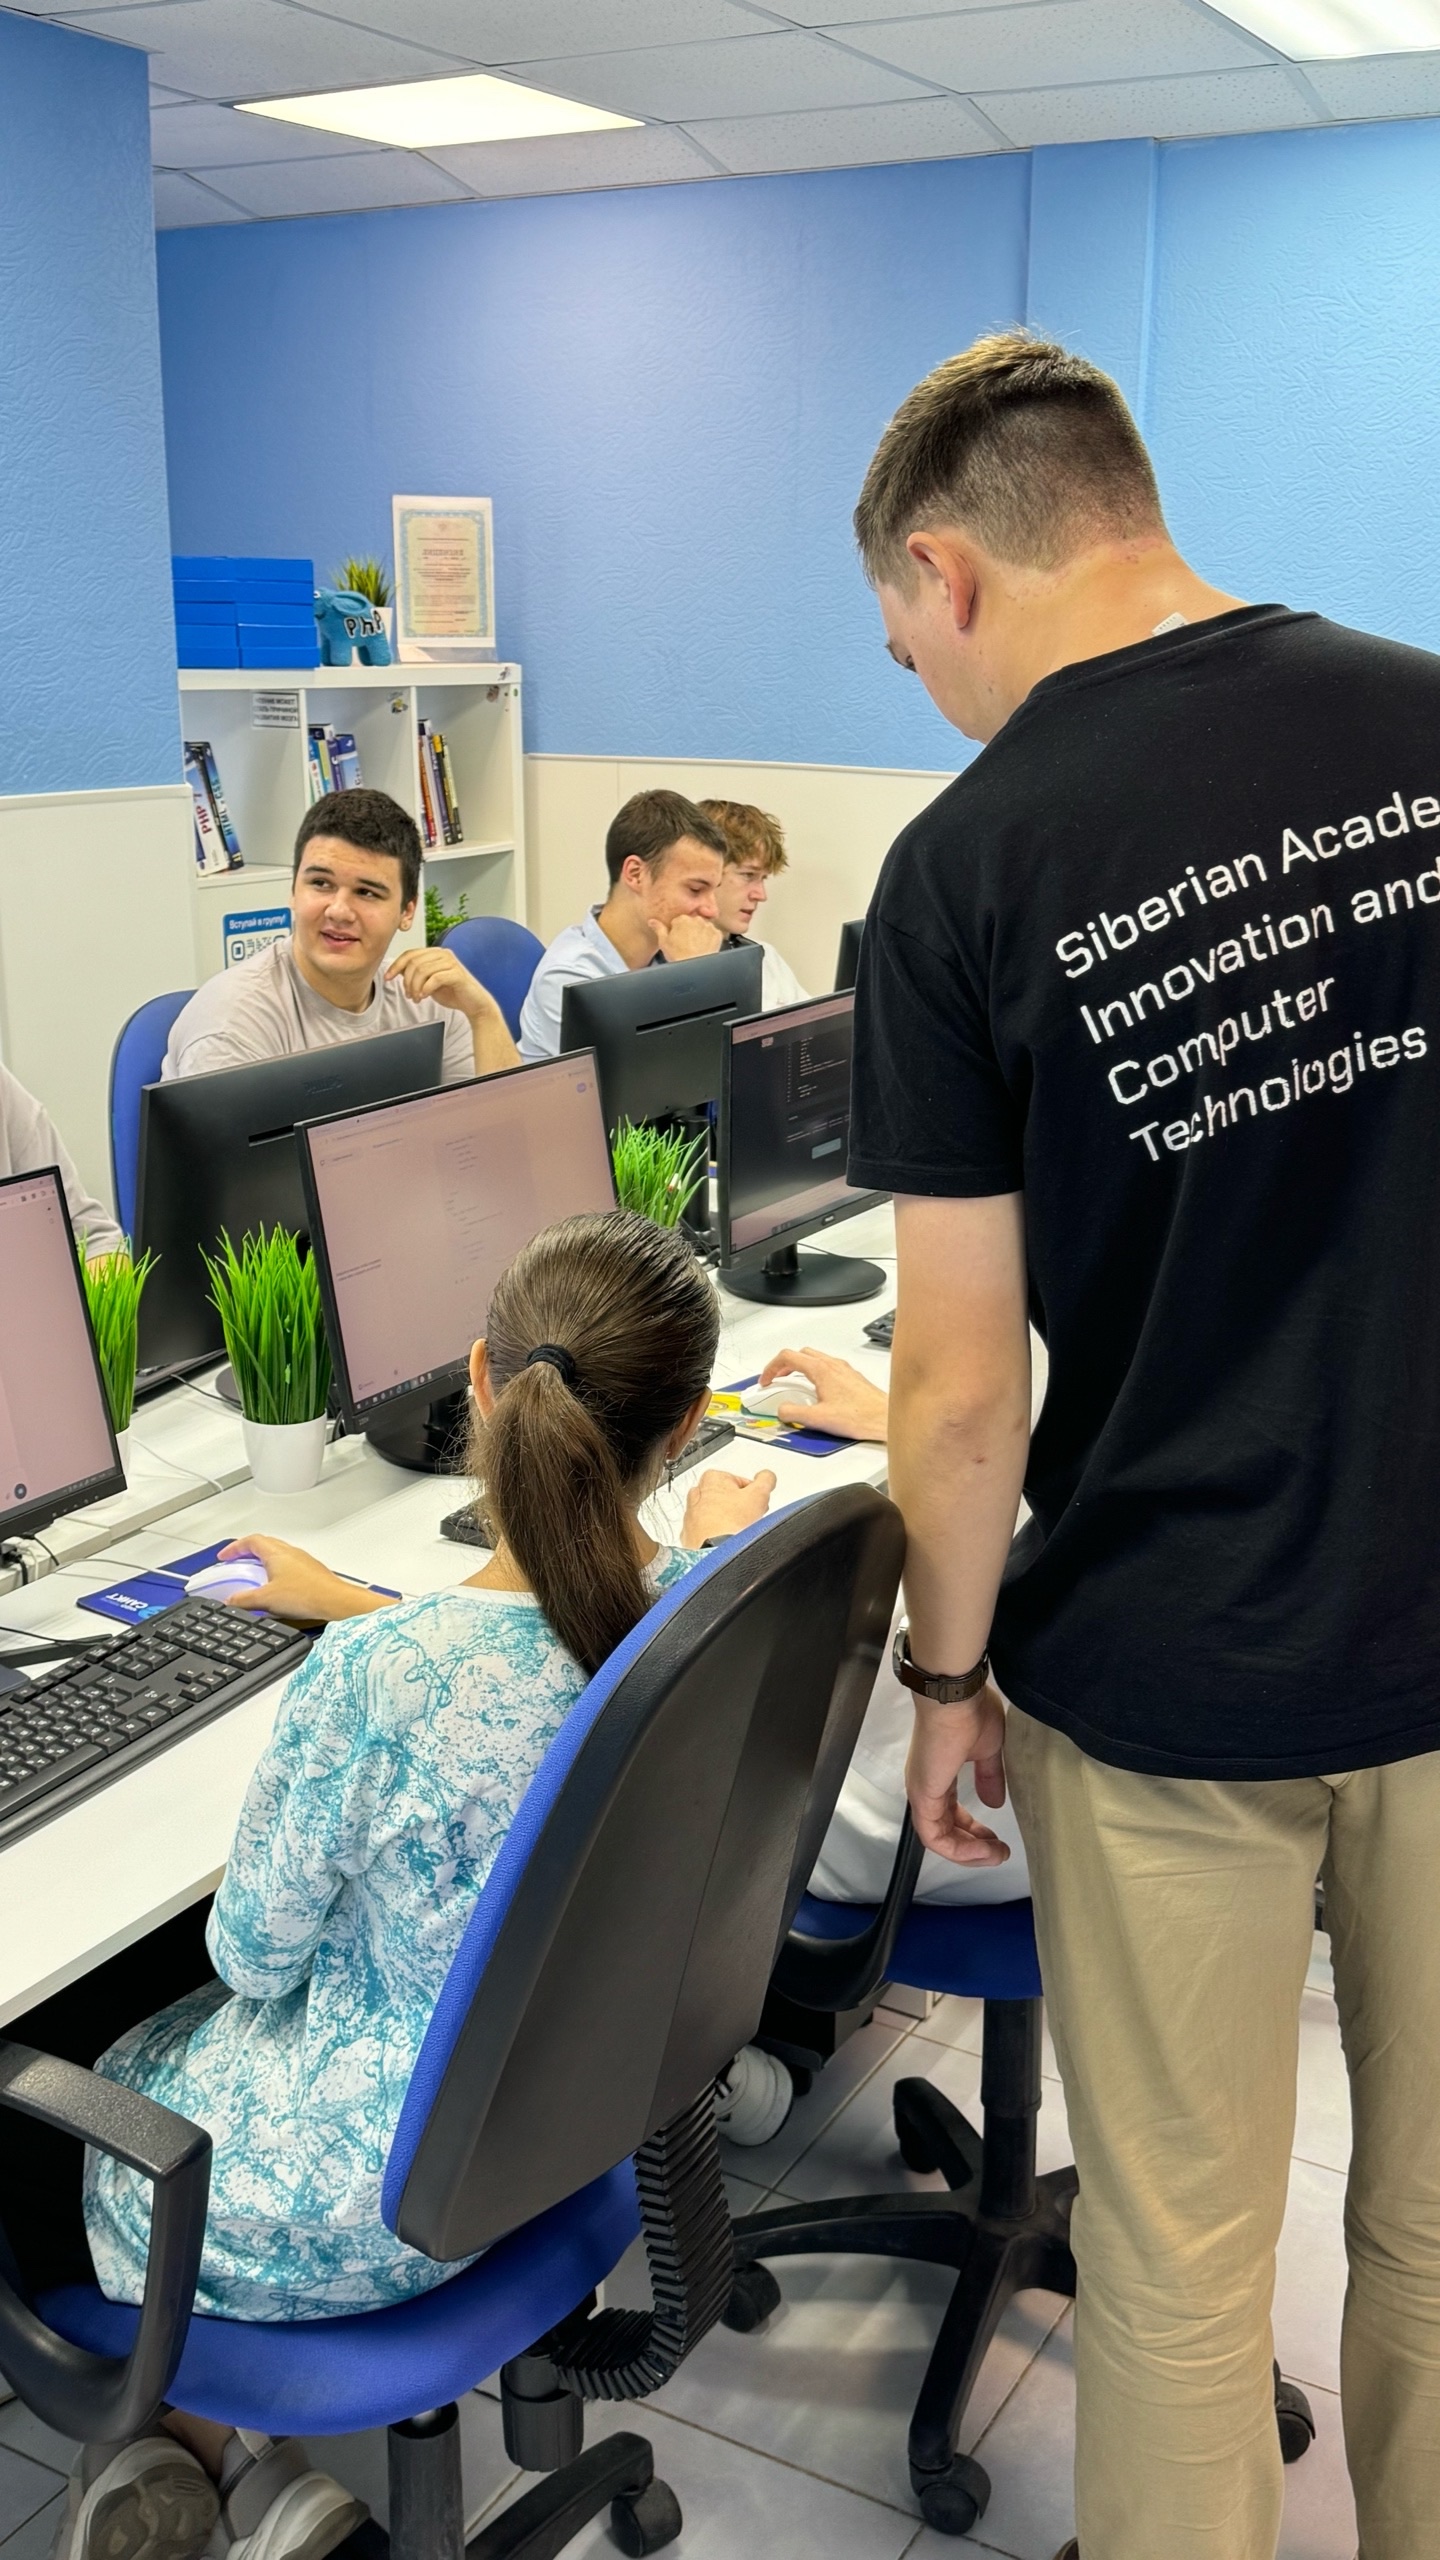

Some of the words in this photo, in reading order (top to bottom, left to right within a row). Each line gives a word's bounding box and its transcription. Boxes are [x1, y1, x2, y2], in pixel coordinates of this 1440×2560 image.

[196, 805, 213, 835] PHP
[219, 807, 234, 836] HTML
[229, 918, 257, 930] Вступай
[1055, 853, 1268, 979] Siberian
[1079, 904, 1335, 1044] Innovation
[1350, 855, 1440, 924] and
[1107, 977, 1335, 1105] Computer
[1128, 1026, 1428, 1162] Technologies
